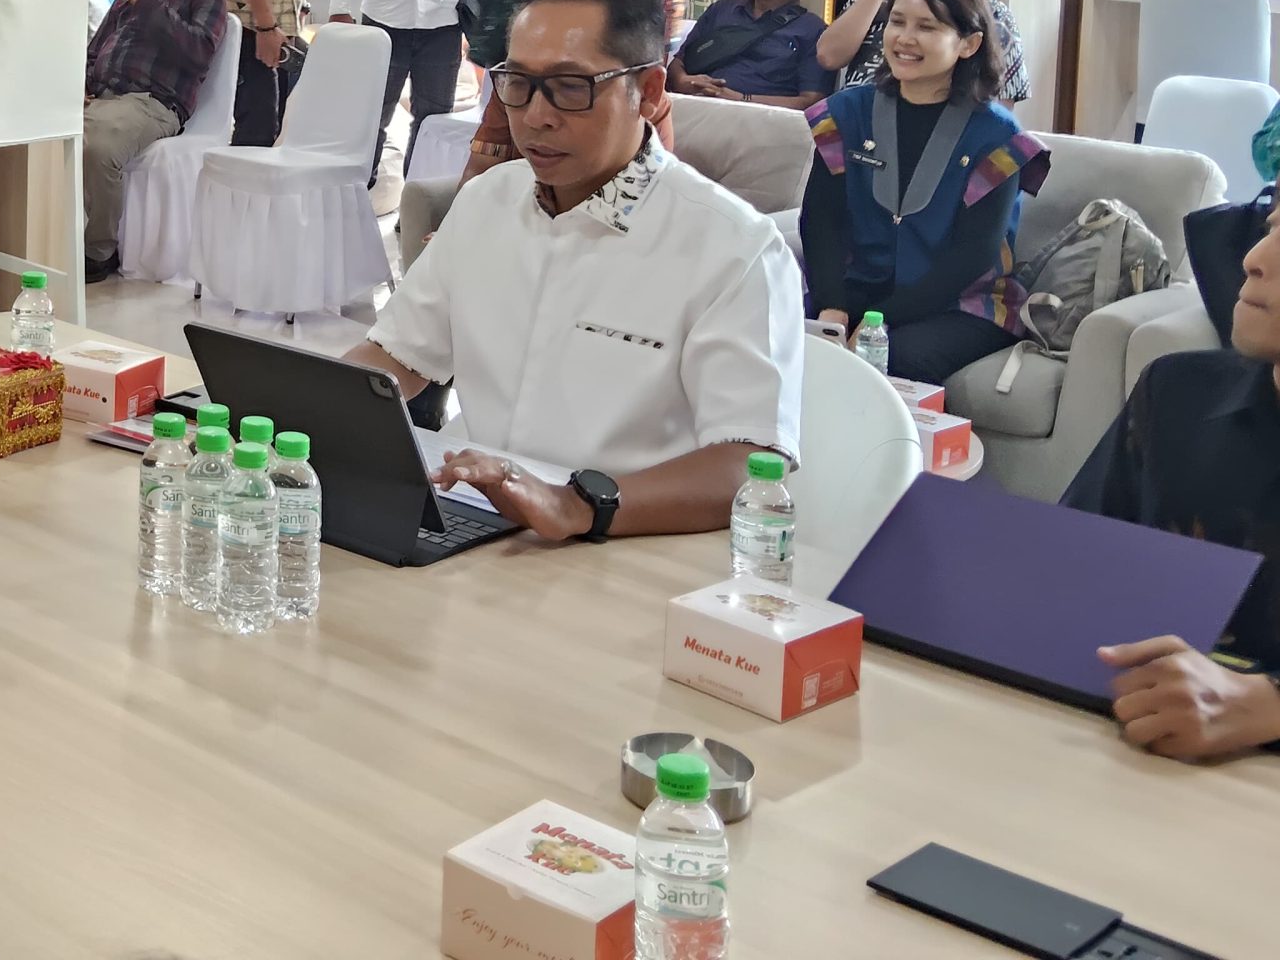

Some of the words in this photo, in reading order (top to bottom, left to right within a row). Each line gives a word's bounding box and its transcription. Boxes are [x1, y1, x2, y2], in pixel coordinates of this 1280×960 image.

[83, 387, 100, 399] Kue
[162, 489, 182, 502] San
[191, 503, 217, 518] Sant
[684, 635, 732, 665] Menata
[735, 655, 760, 675] Kue
[656, 882, 710, 907] Santri
